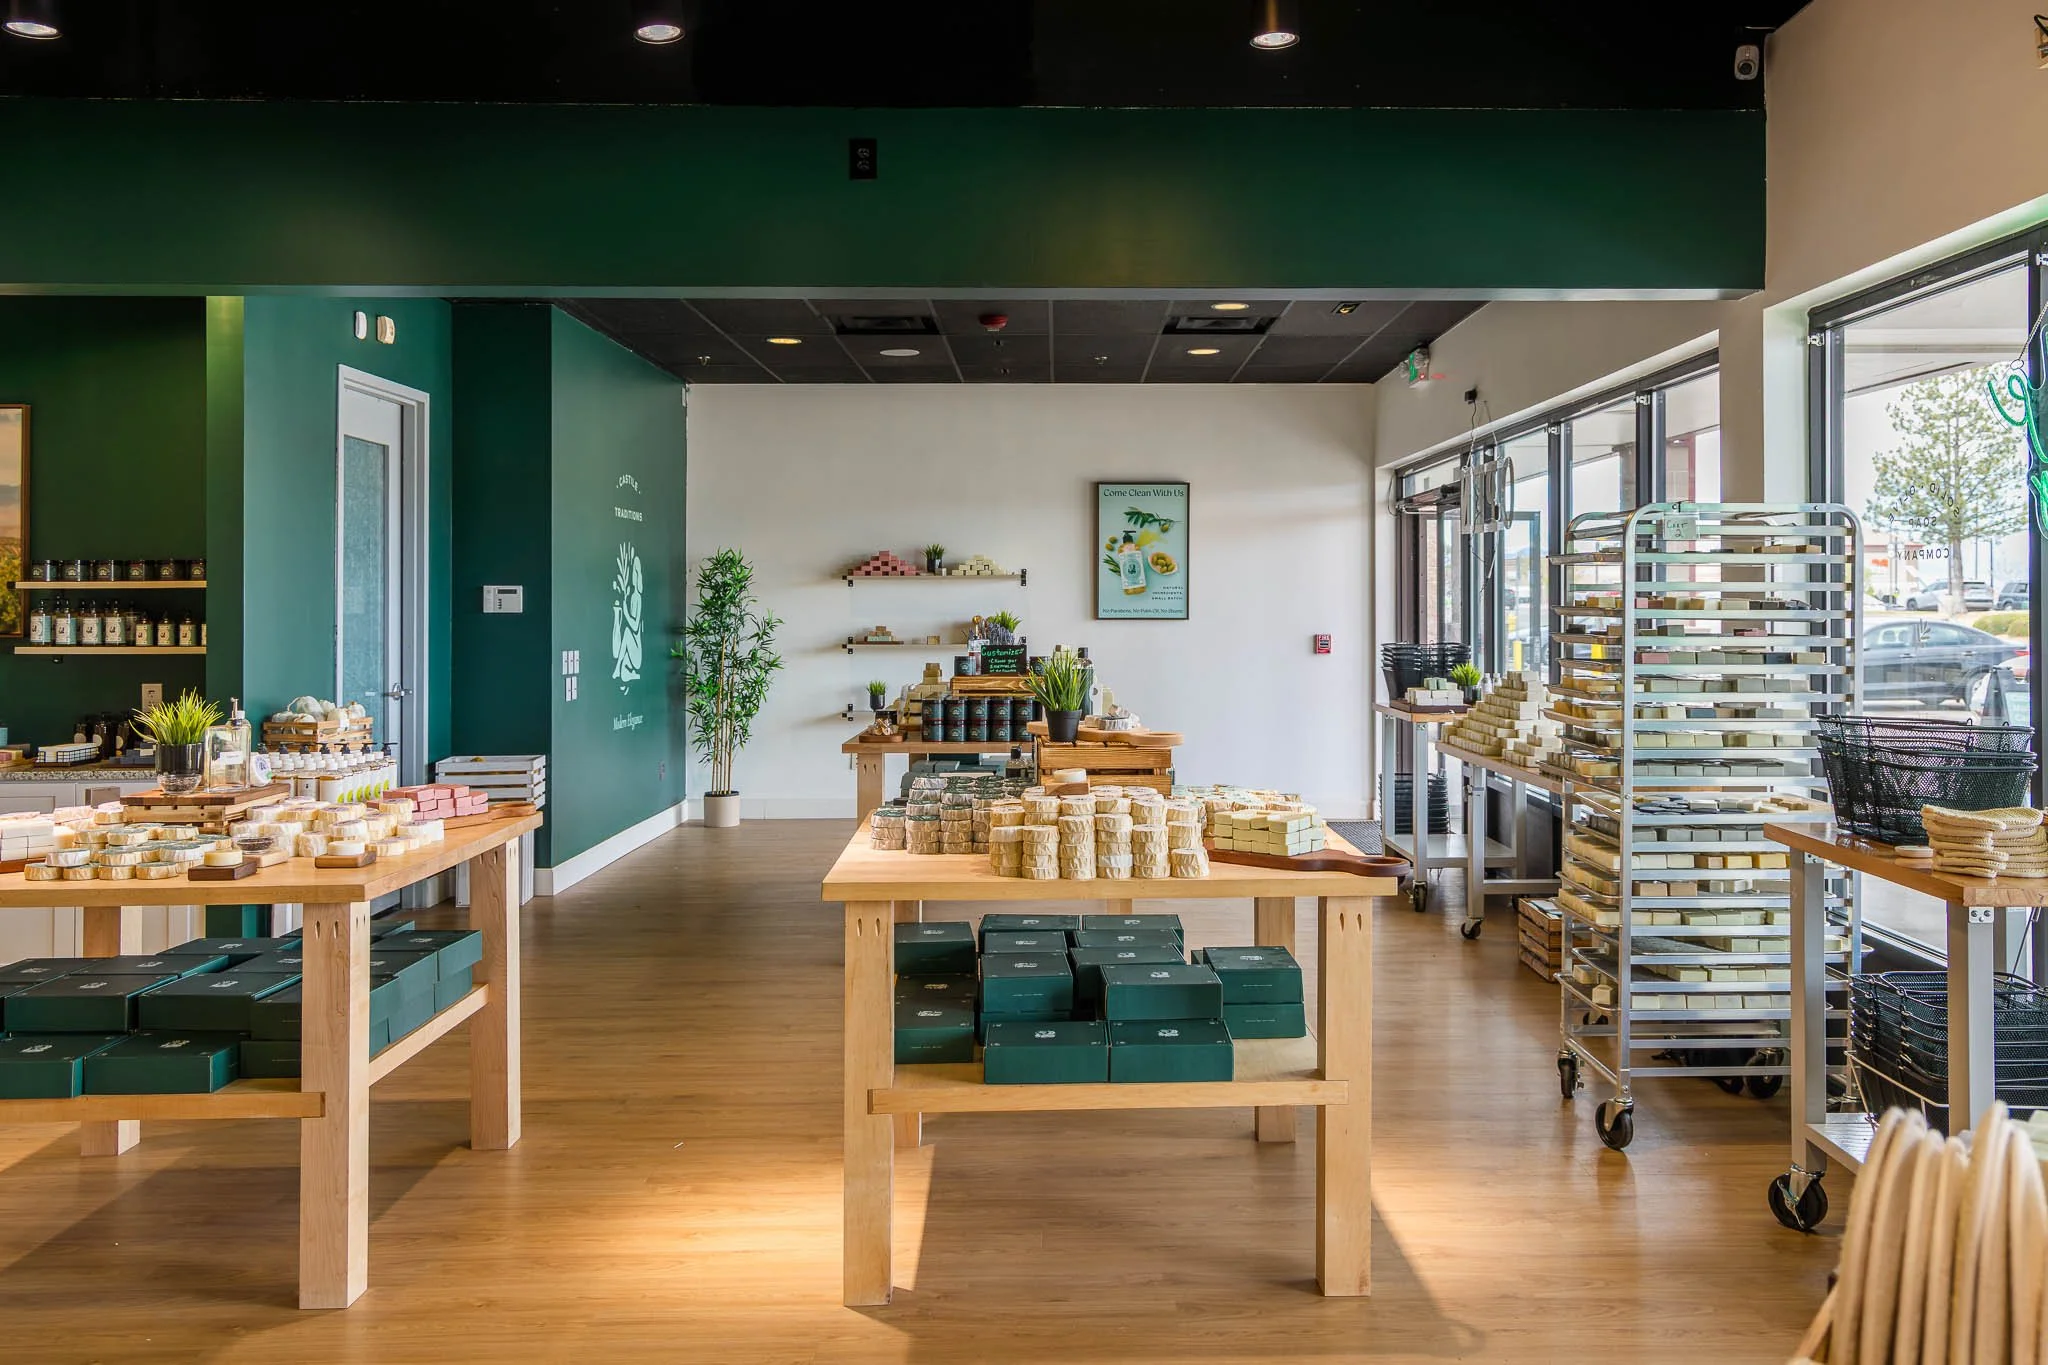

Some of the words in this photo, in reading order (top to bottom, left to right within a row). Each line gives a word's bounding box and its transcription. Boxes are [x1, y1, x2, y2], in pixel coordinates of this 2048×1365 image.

[619, 474, 638, 492] CASTILE
[1103, 488, 1128, 497] Come
[1129, 488, 1151, 497] Clean
[1152, 488, 1172, 497] With
[1173, 488, 1185, 497] Us
[614, 506, 643, 522] TRADITIONS
